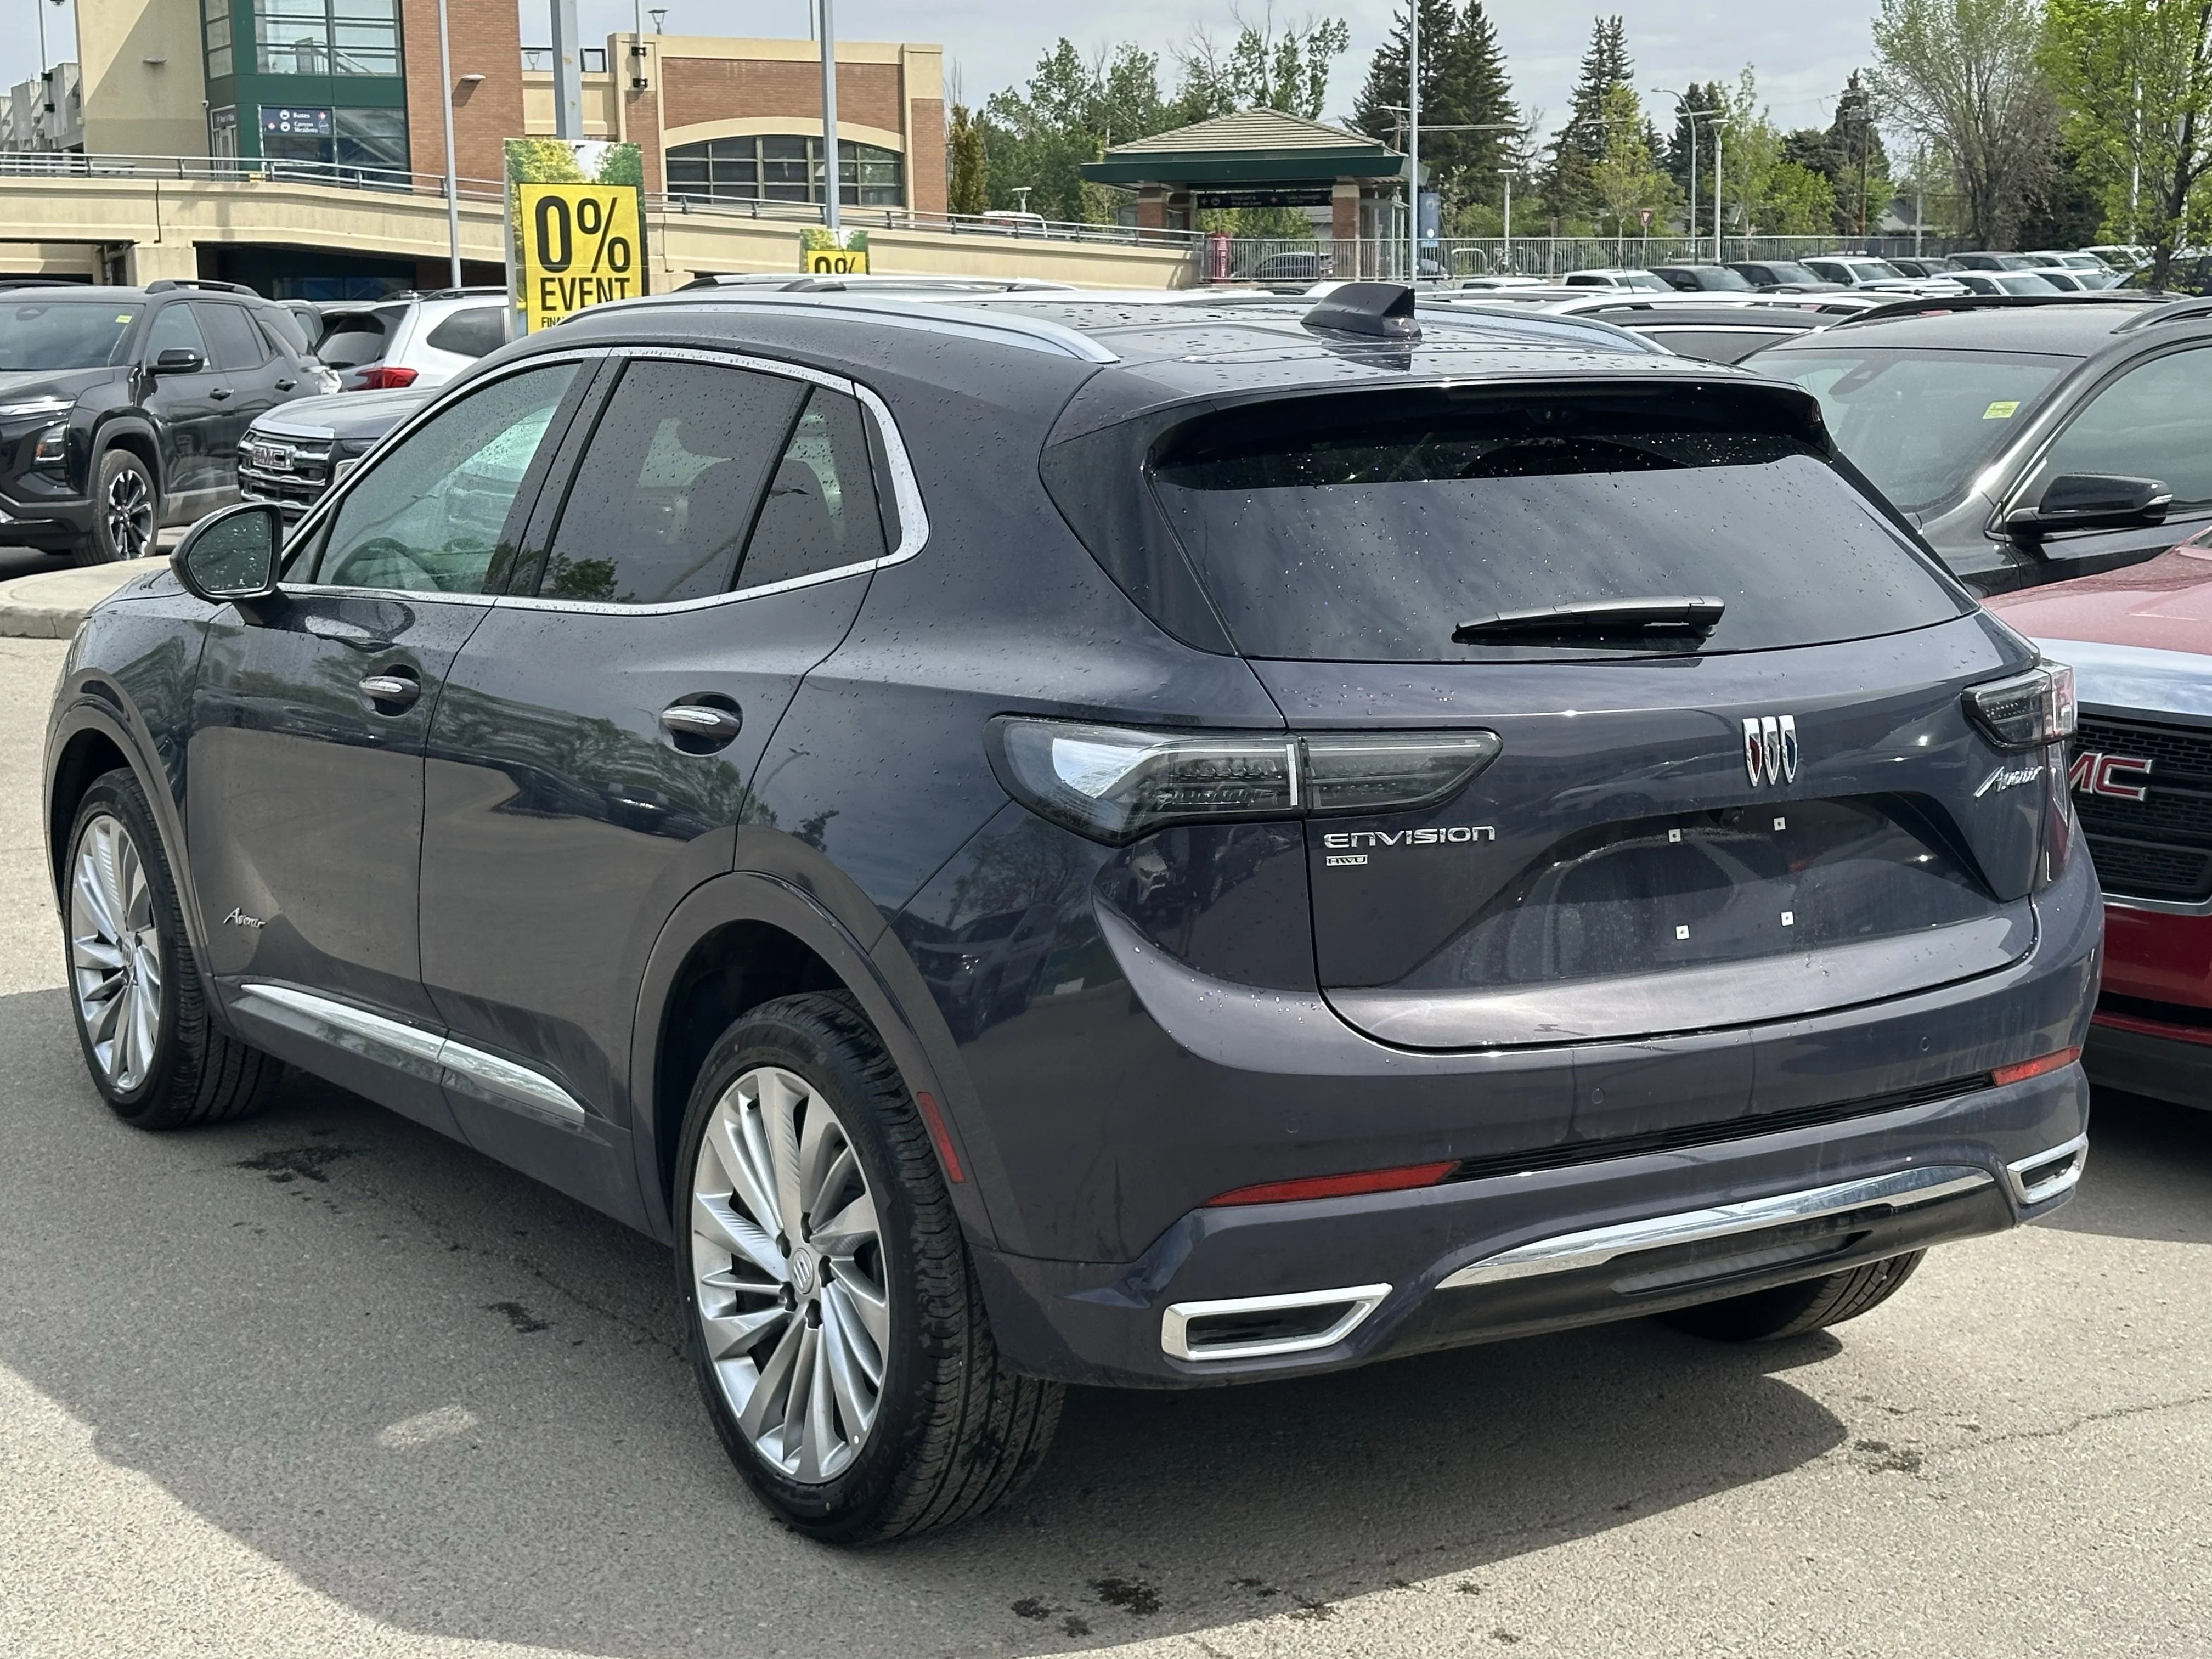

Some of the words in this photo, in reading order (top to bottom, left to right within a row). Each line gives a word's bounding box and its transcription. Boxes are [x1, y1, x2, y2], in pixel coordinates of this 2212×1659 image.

[535, 195, 631, 273] 0%
[540, 277, 630, 311] EVENT
[1324, 826, 1496, 848] ENVISION
